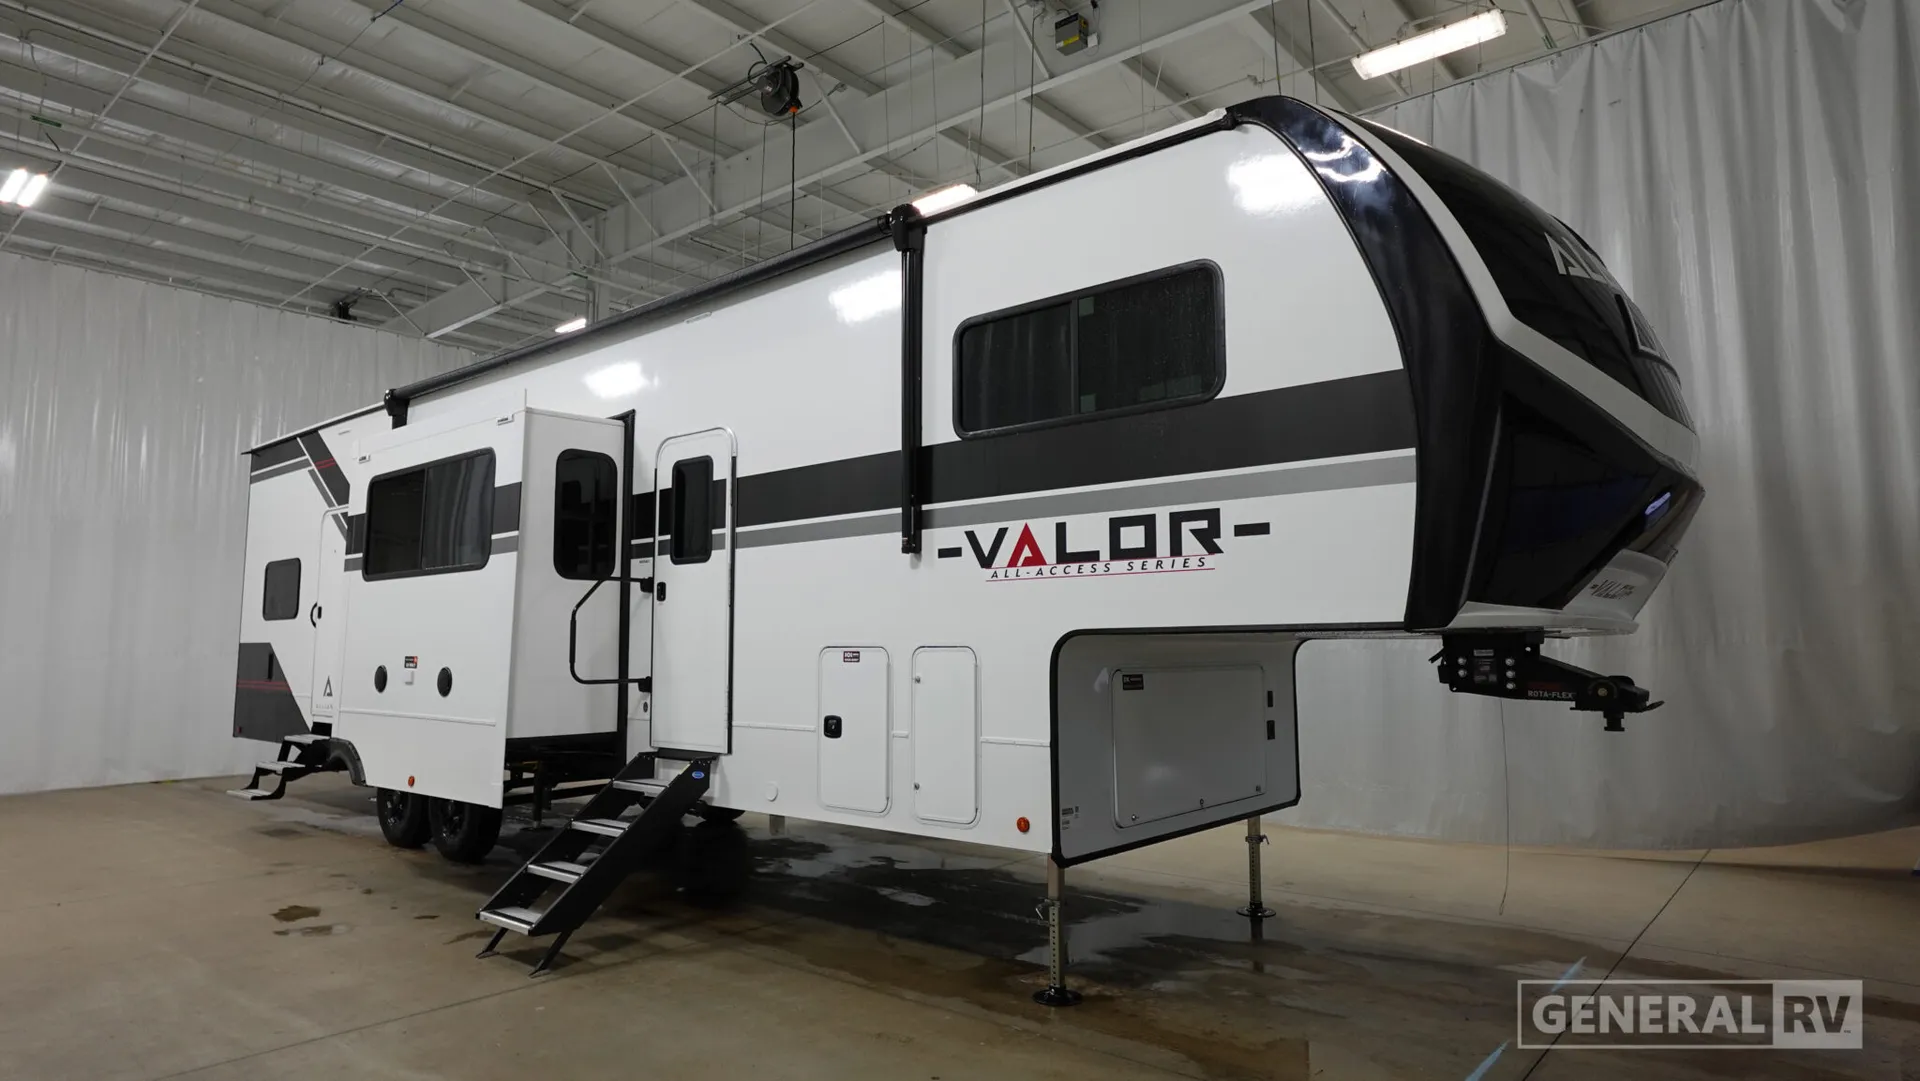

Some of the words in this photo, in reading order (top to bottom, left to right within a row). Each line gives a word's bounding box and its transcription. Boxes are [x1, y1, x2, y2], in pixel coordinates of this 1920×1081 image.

[991, 562, 1111, 579] ALL-ACCESS
[1126, 556, 1206, 572] SERIES
[1527, 689, 1574, 699] ROTA-FLEX
